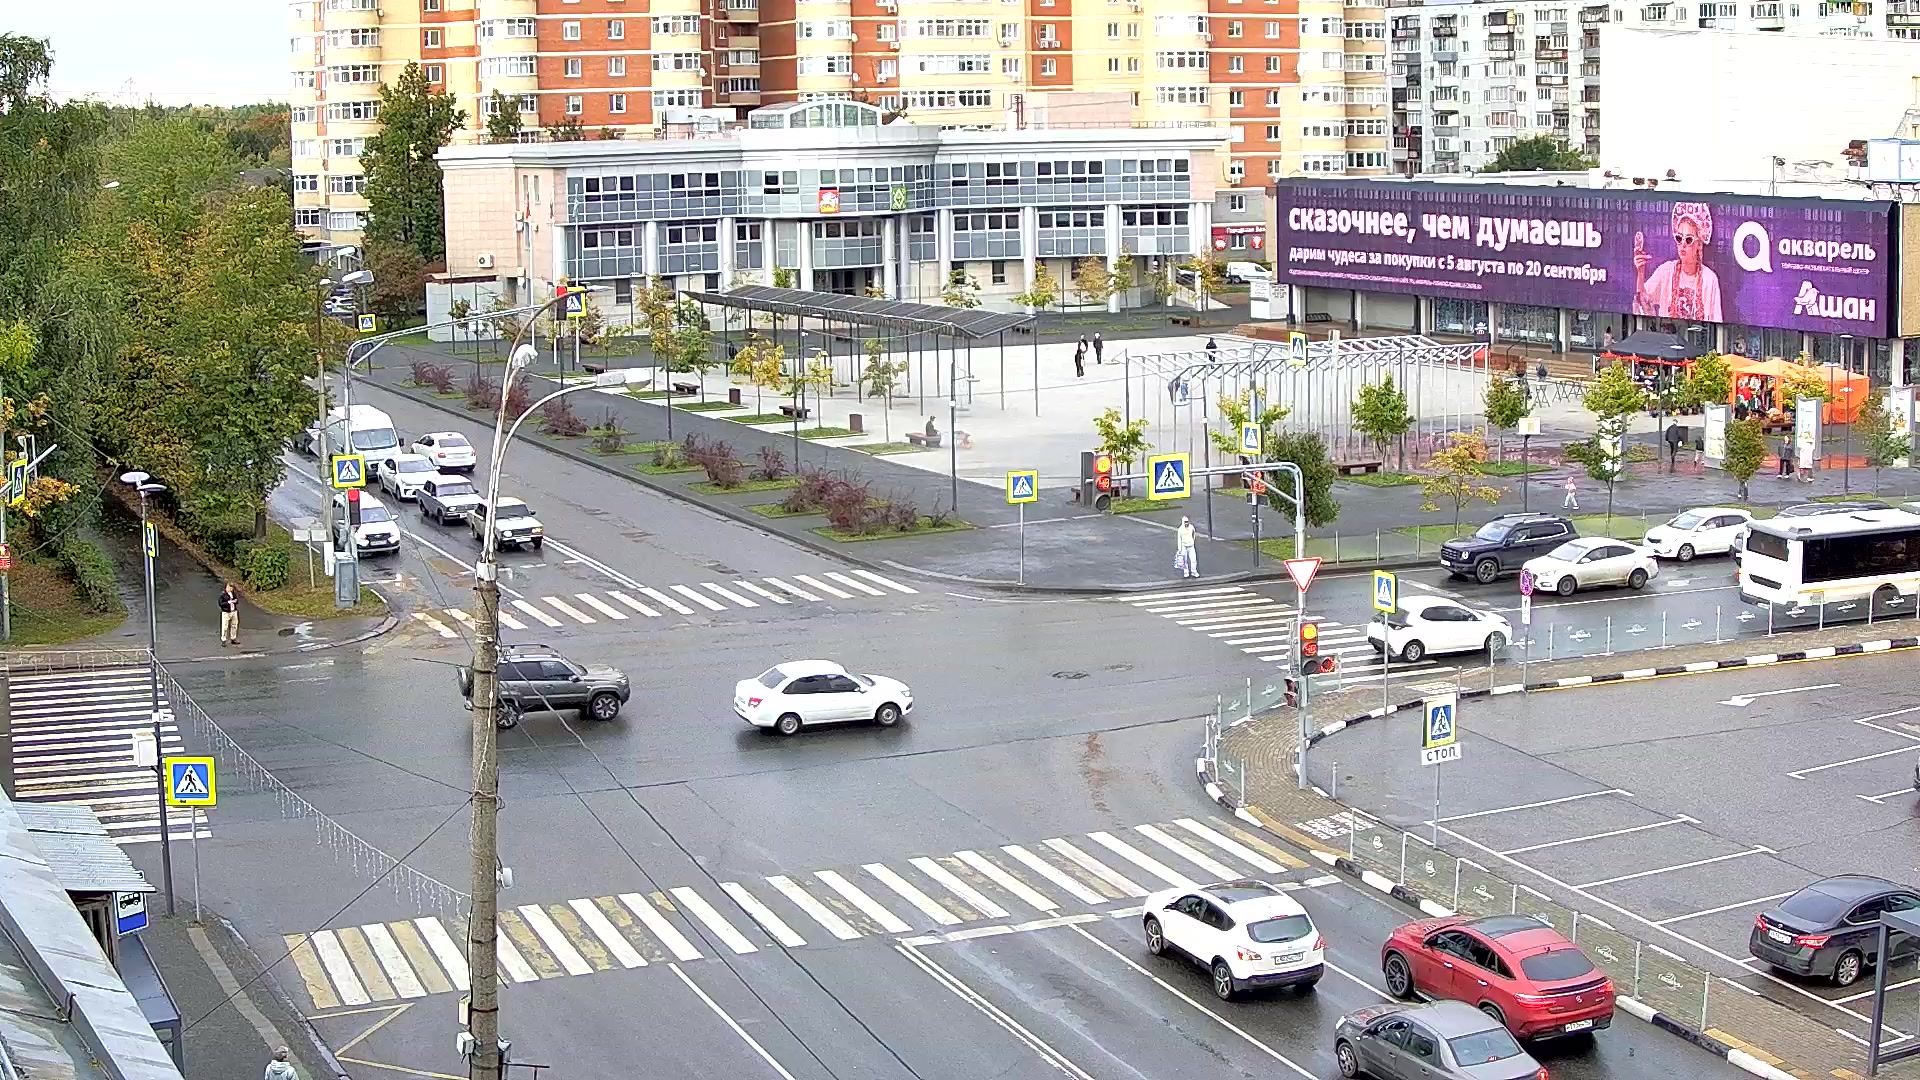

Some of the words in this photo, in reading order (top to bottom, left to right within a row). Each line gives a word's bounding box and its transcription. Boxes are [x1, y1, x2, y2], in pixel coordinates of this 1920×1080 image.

[1288, 206, 1417, 244] сказочнее,
[1422, 213, 1470, 240] чем
[1475, 216, 1602, 251] думаешь
[1289, 246, 1326, 263] дарим
[1327, 249, 1367, 266] чудеса
[1368, 252, 1382, 264] за
[1384, 253, 1436, 271] покупки
[1438, 258, 1446, 269] с
[1447, 255, 1455, 270] 5
[1456, 257, 1505, 276] августа
[1507, 261, 1524, 275] по
[1525, 260, 1542, 276] 20
[1543, 264, 1607, 285] сентября
[1778, 238, 1877, 262] акварель
[1426, 746, 1457, 762] СТОП
